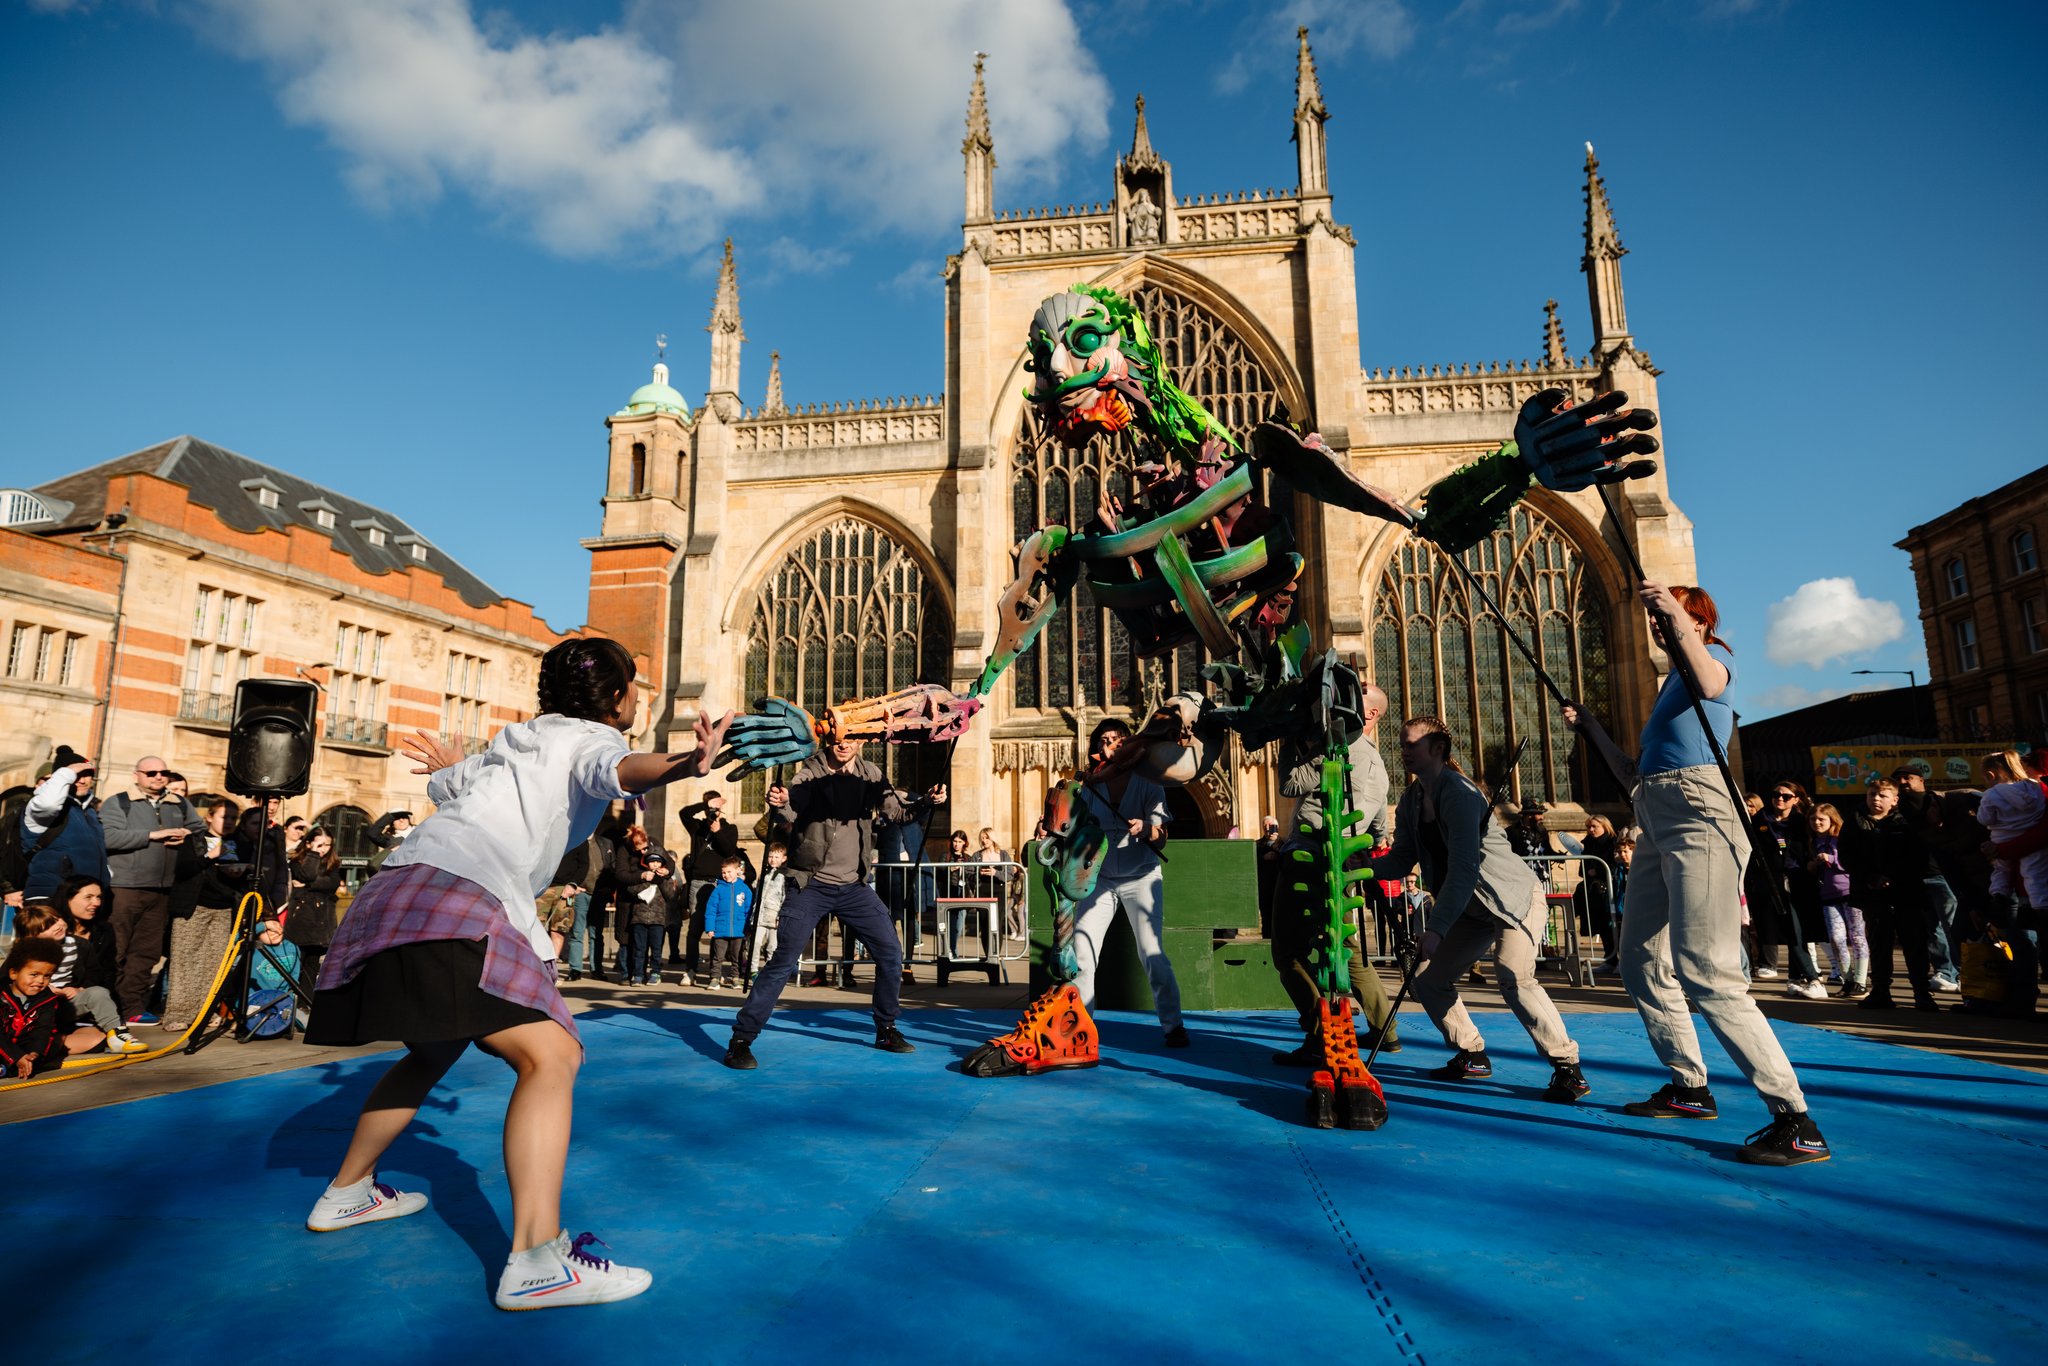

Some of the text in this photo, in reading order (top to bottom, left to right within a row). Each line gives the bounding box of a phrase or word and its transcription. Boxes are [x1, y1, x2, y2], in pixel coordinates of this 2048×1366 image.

[1874, 750, 1897, 759] HULL
[1899, 749, 1937, 758] MINSTER
[1940, 749, 1963, 758] BEER
[521, 1276, 557, 1287] FEIYUE
